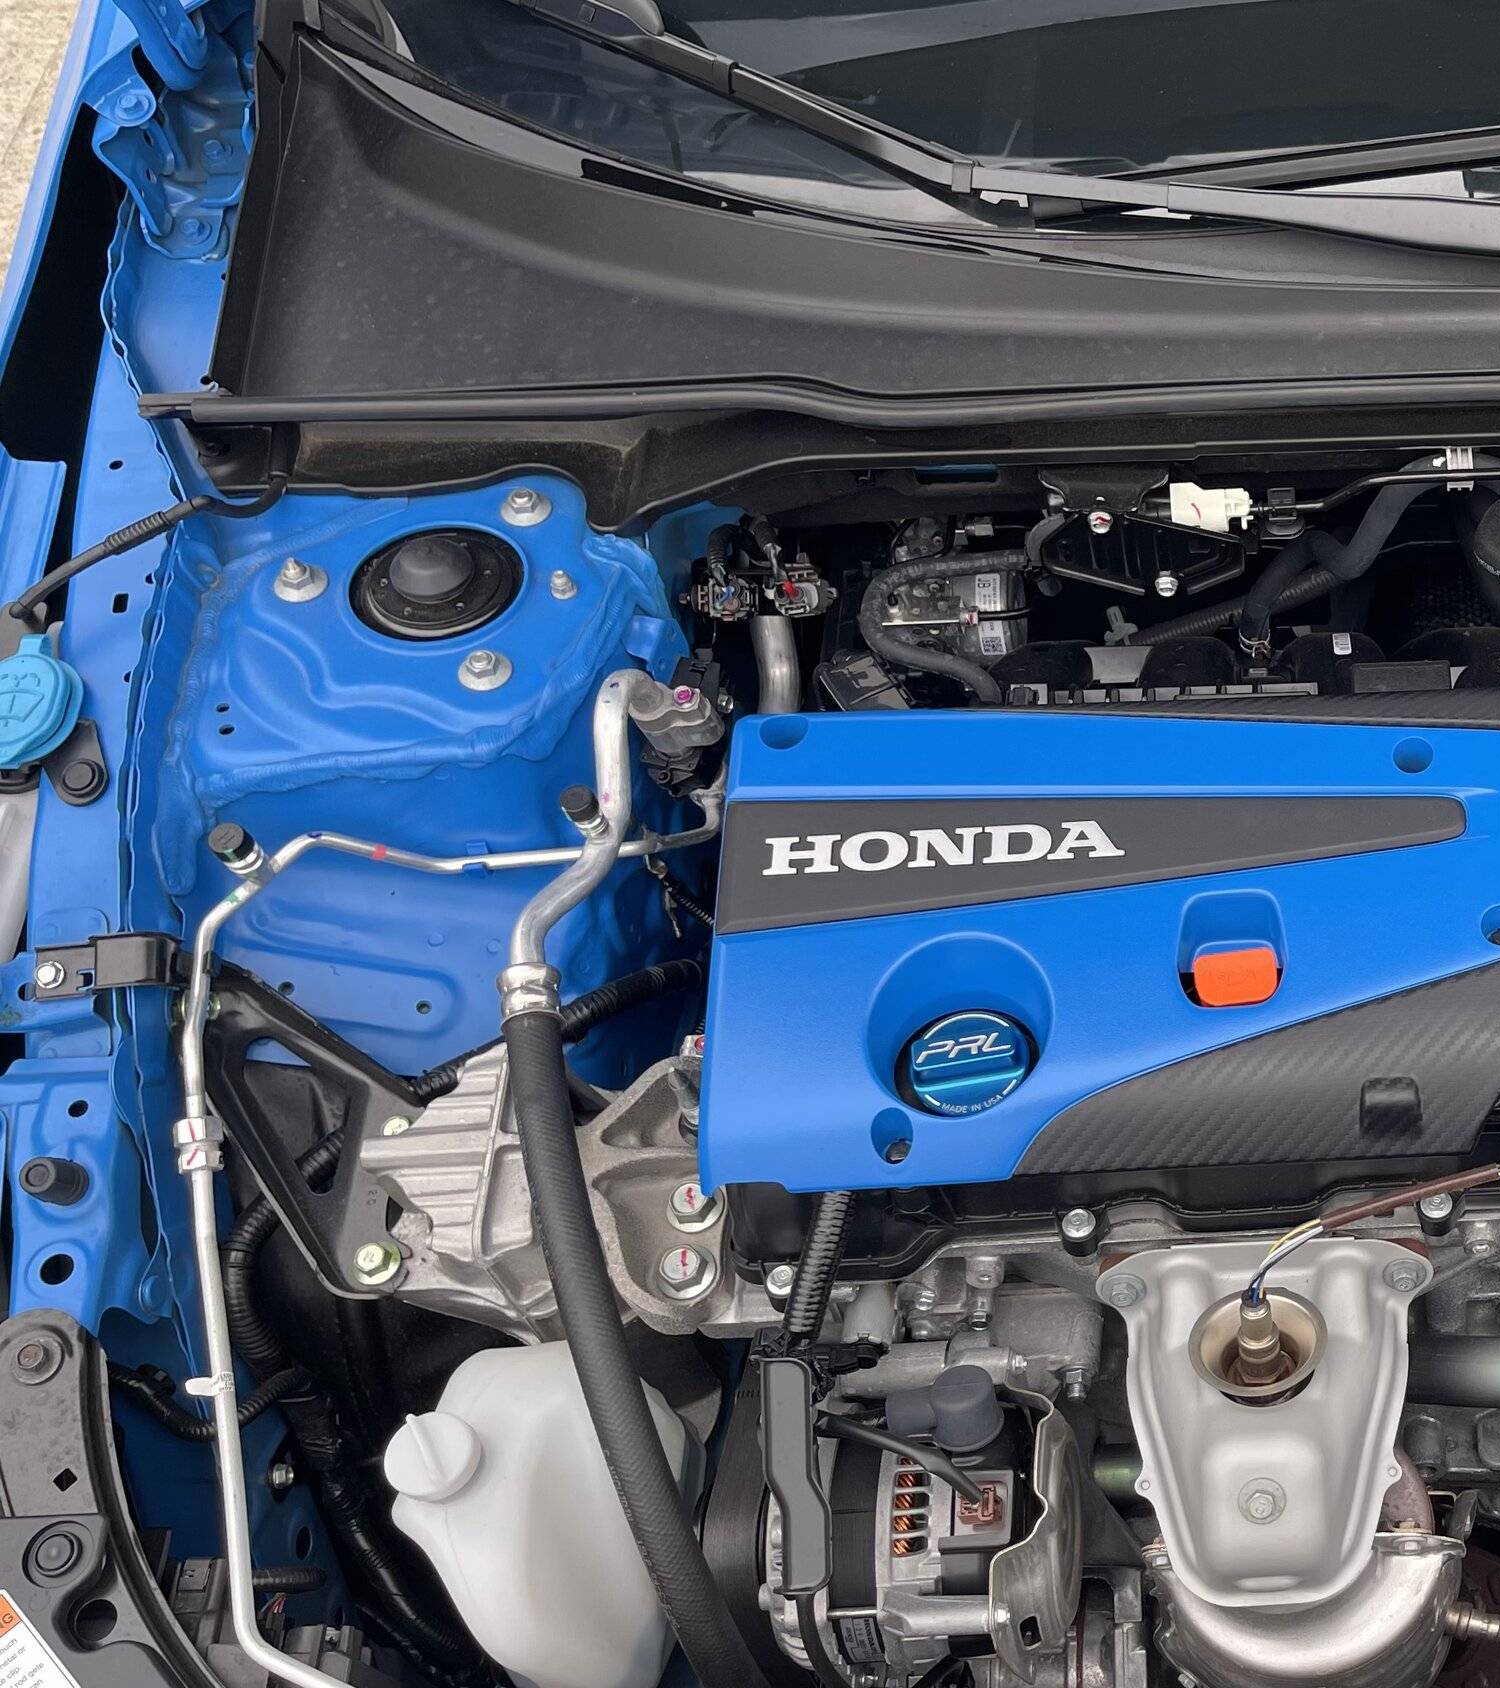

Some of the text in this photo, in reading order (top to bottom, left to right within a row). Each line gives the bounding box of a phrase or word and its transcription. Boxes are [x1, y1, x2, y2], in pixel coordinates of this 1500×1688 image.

[762, 820, 1125, 876] HONDA
[916, 1032, 1014, 1063] PRL
[941, 1103, 967, 1113] MADE
[984, 1094, 1004, 1108] USA
